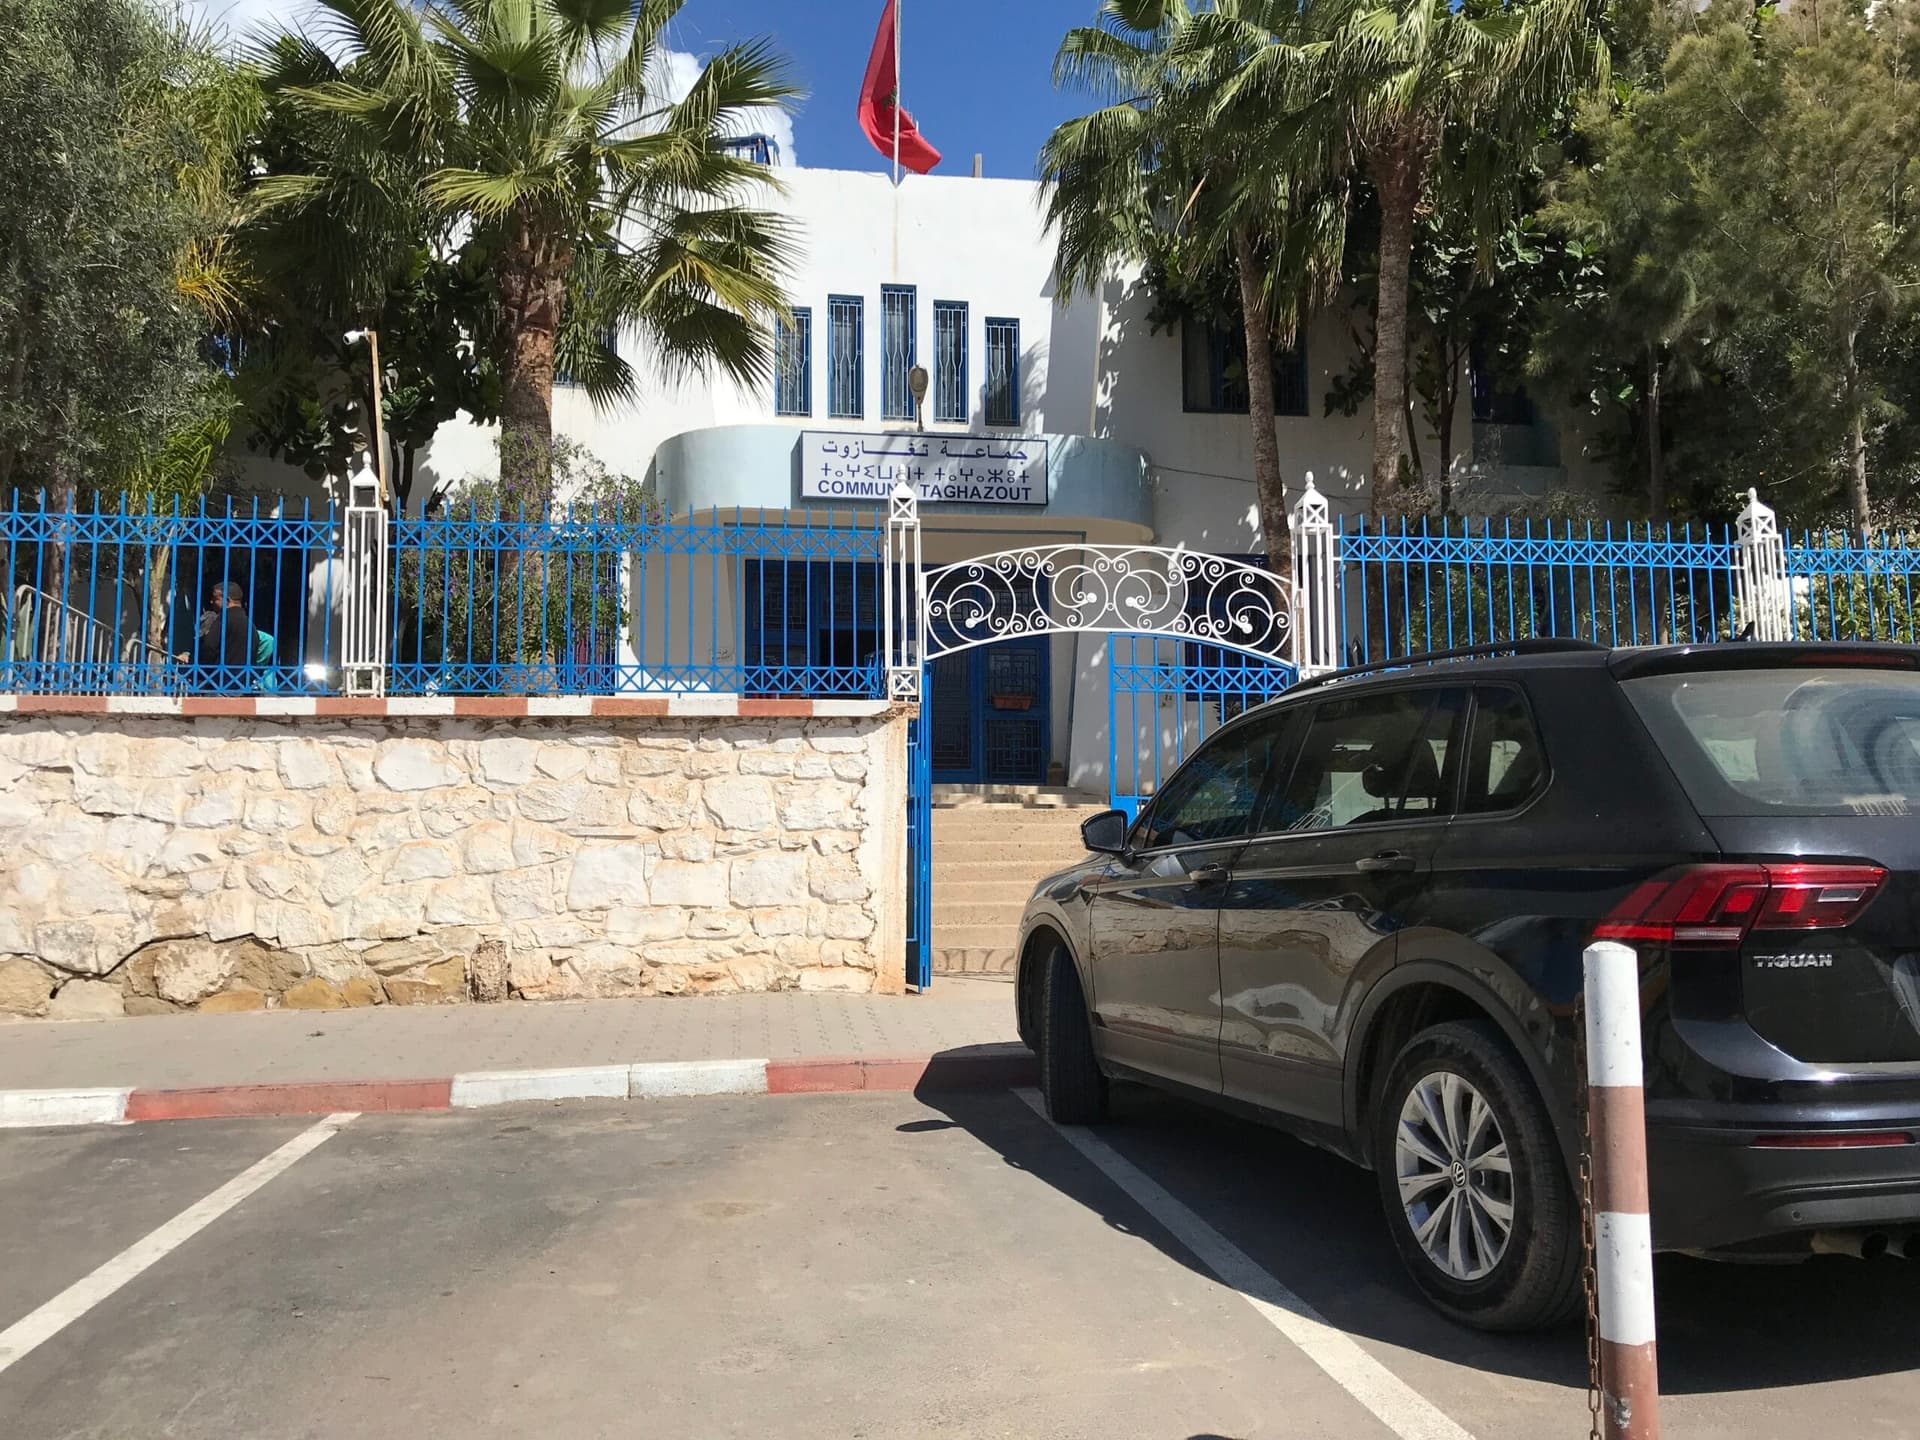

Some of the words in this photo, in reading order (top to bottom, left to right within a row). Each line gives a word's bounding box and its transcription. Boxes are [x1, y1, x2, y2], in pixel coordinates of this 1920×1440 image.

[822, 439, 928, 459] تغازوت
[940, 440, 1027, 465] جماعة
[818, 480, 909, 497] COMMUN
[919, 484, 1032, 501] TAGHAZOUT
[1753, 954, 1833, 968] TIGUAN
